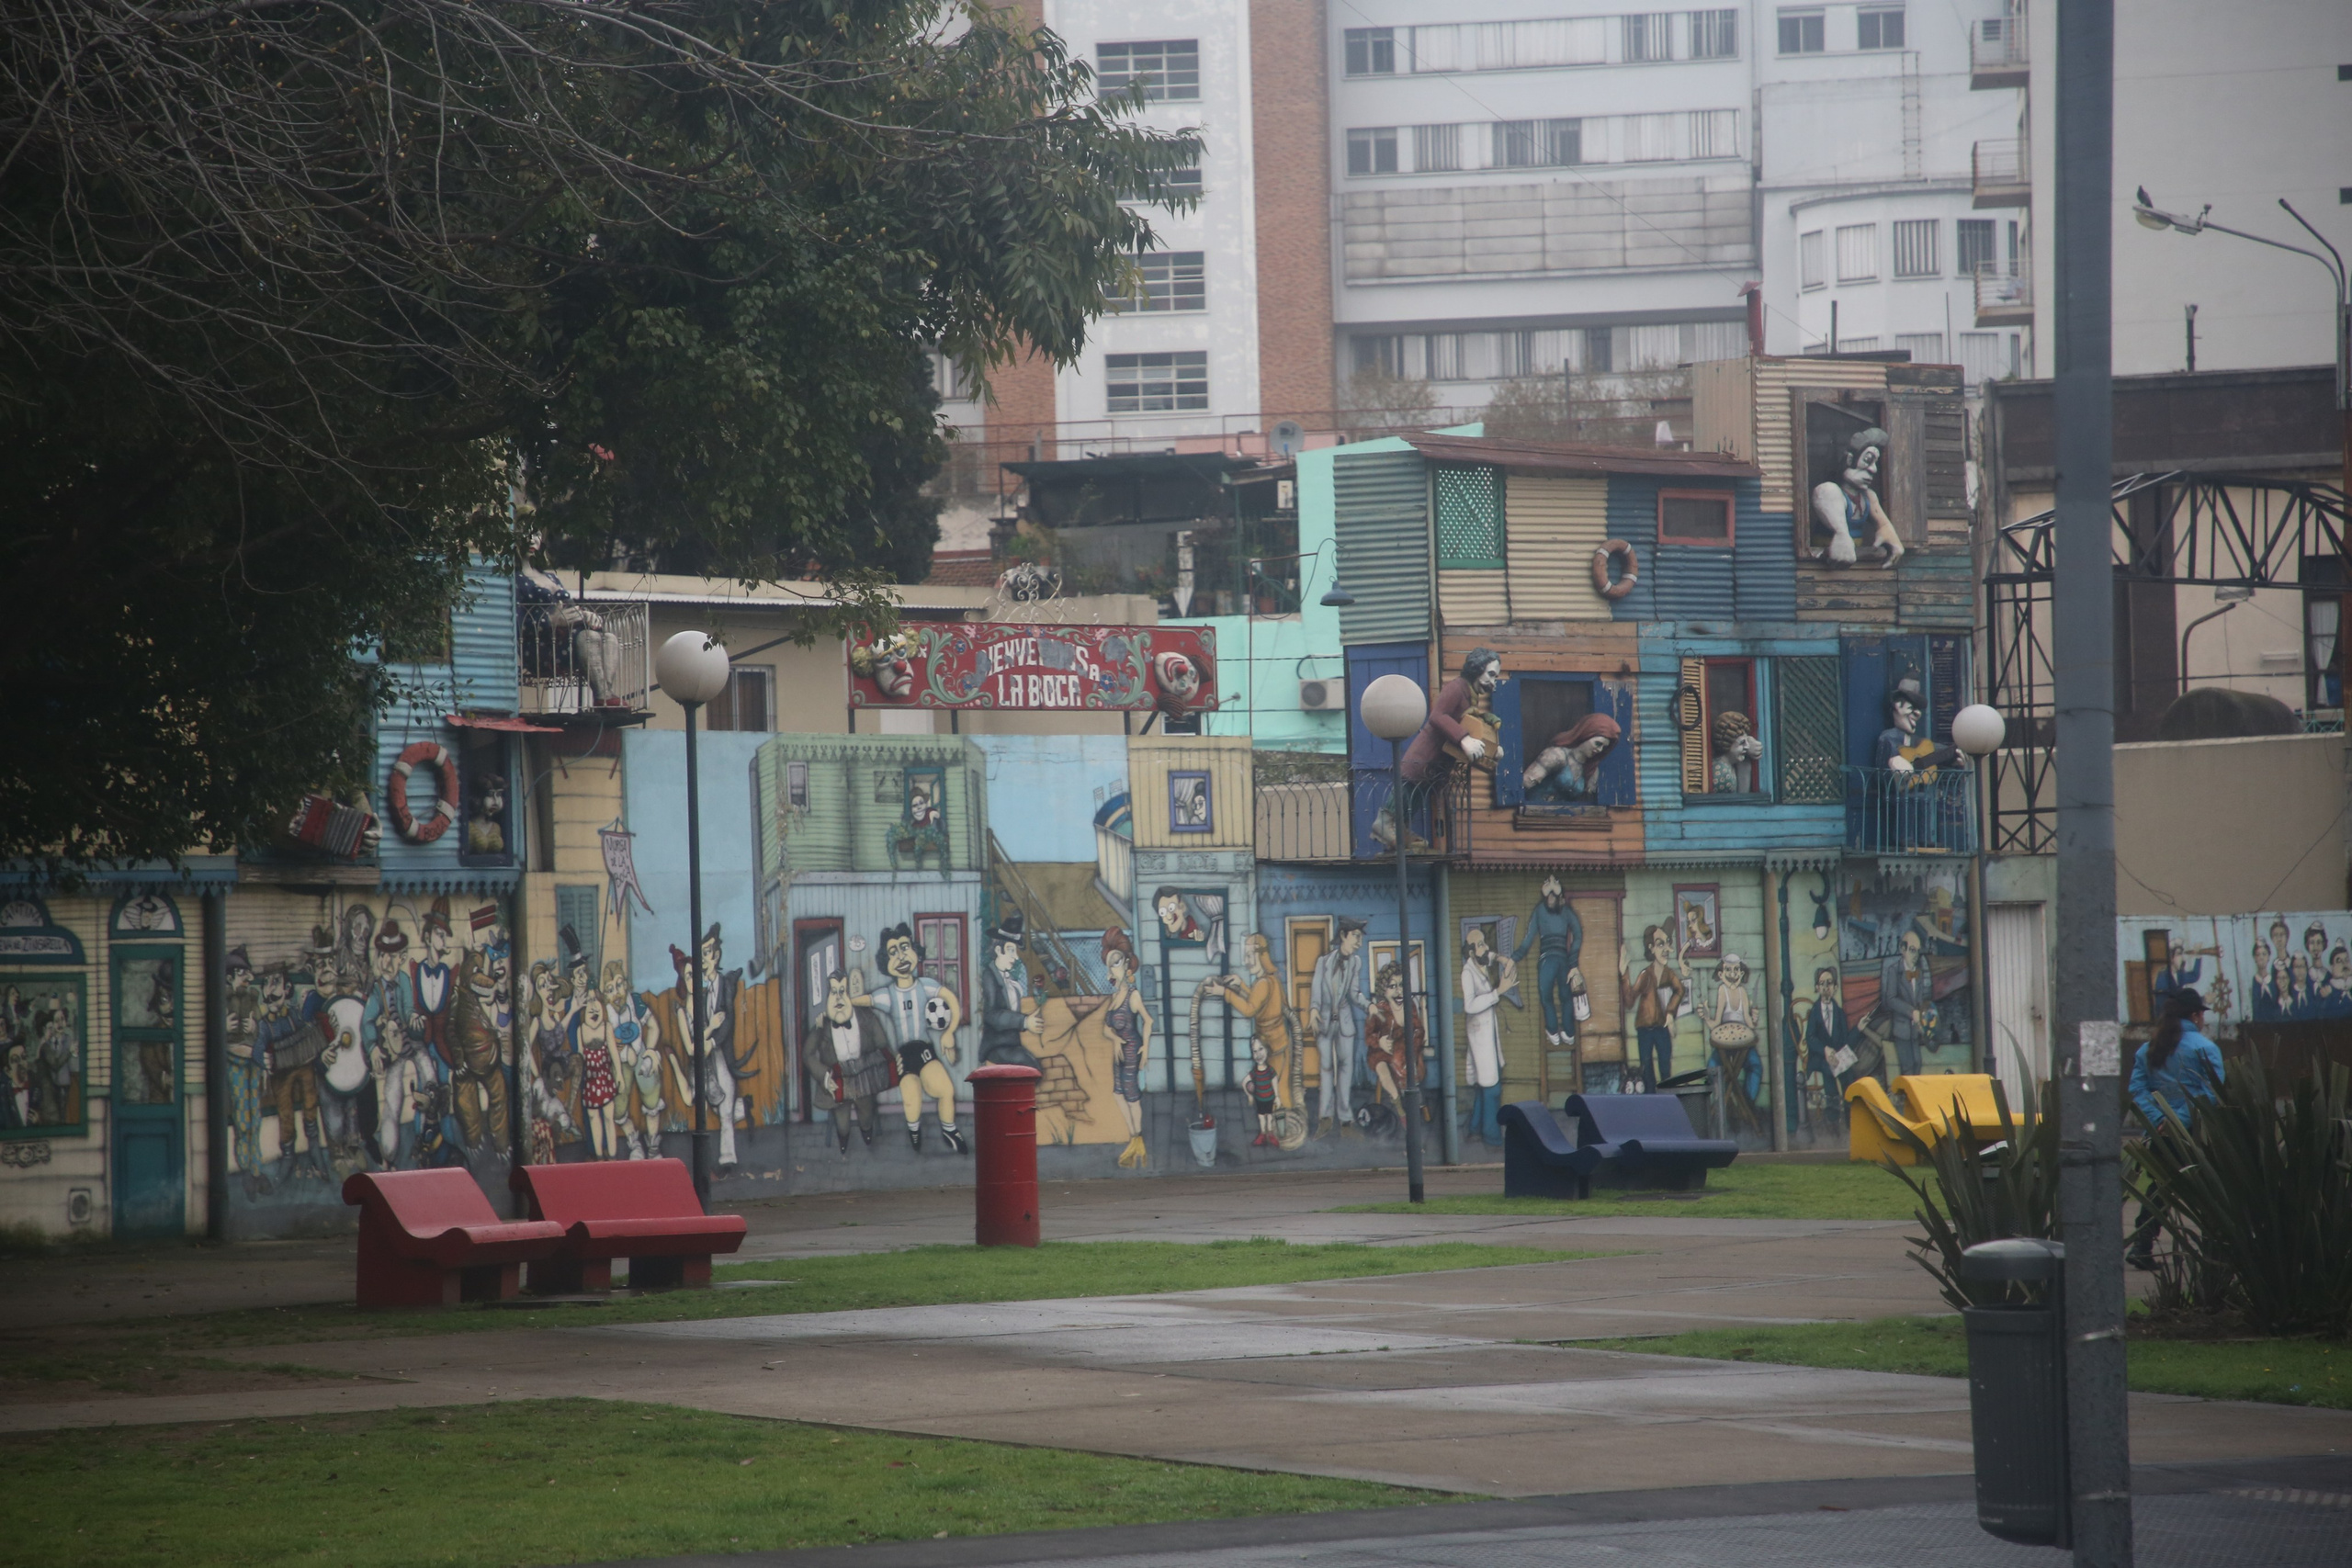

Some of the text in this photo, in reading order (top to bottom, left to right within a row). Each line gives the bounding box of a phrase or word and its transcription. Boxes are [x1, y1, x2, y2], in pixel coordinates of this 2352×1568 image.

[998, 674, 1083, 707] LA BOCA
[903, 999, 913, 1011] 10
[921, 1049, 933, 1064] 10
